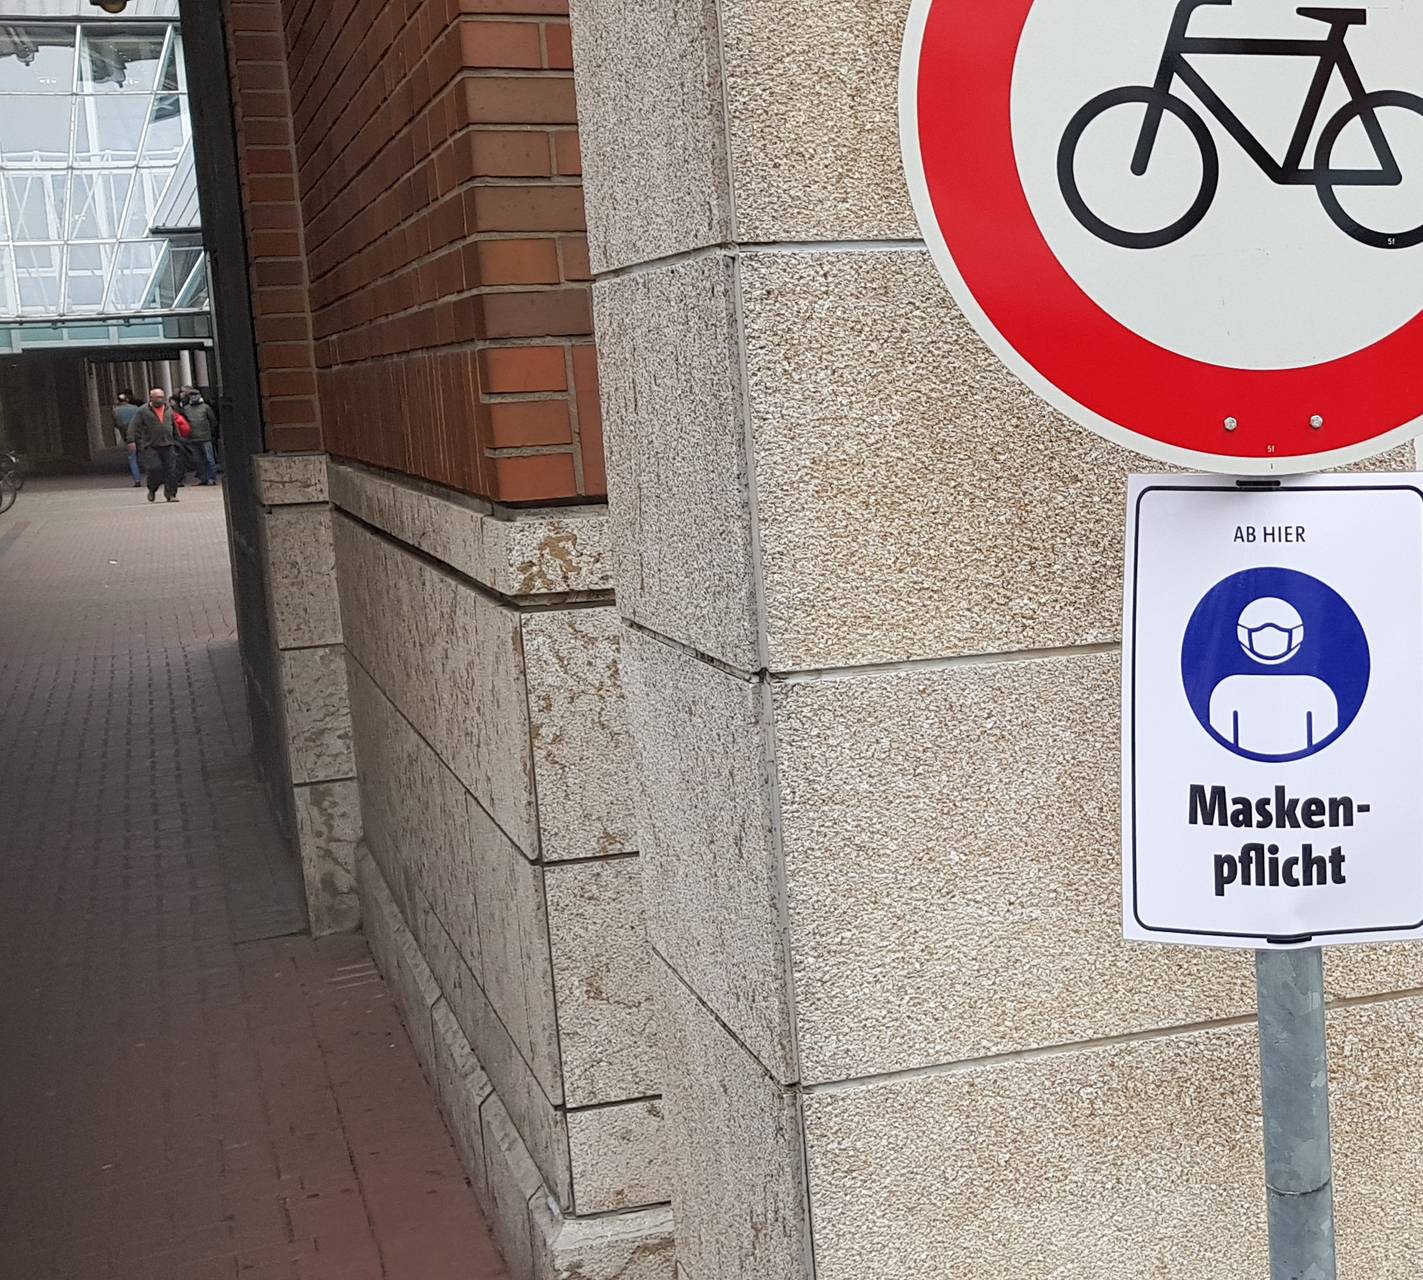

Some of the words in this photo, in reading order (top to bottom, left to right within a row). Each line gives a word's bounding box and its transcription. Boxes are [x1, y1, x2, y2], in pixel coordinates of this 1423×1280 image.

[1233, 525, 1257, 543] AB
[1263, 525, 1306, 543] HIER
[1188, 783, 1371, 829] Masken-
[1213, 842, 1347, 897] pflicht
